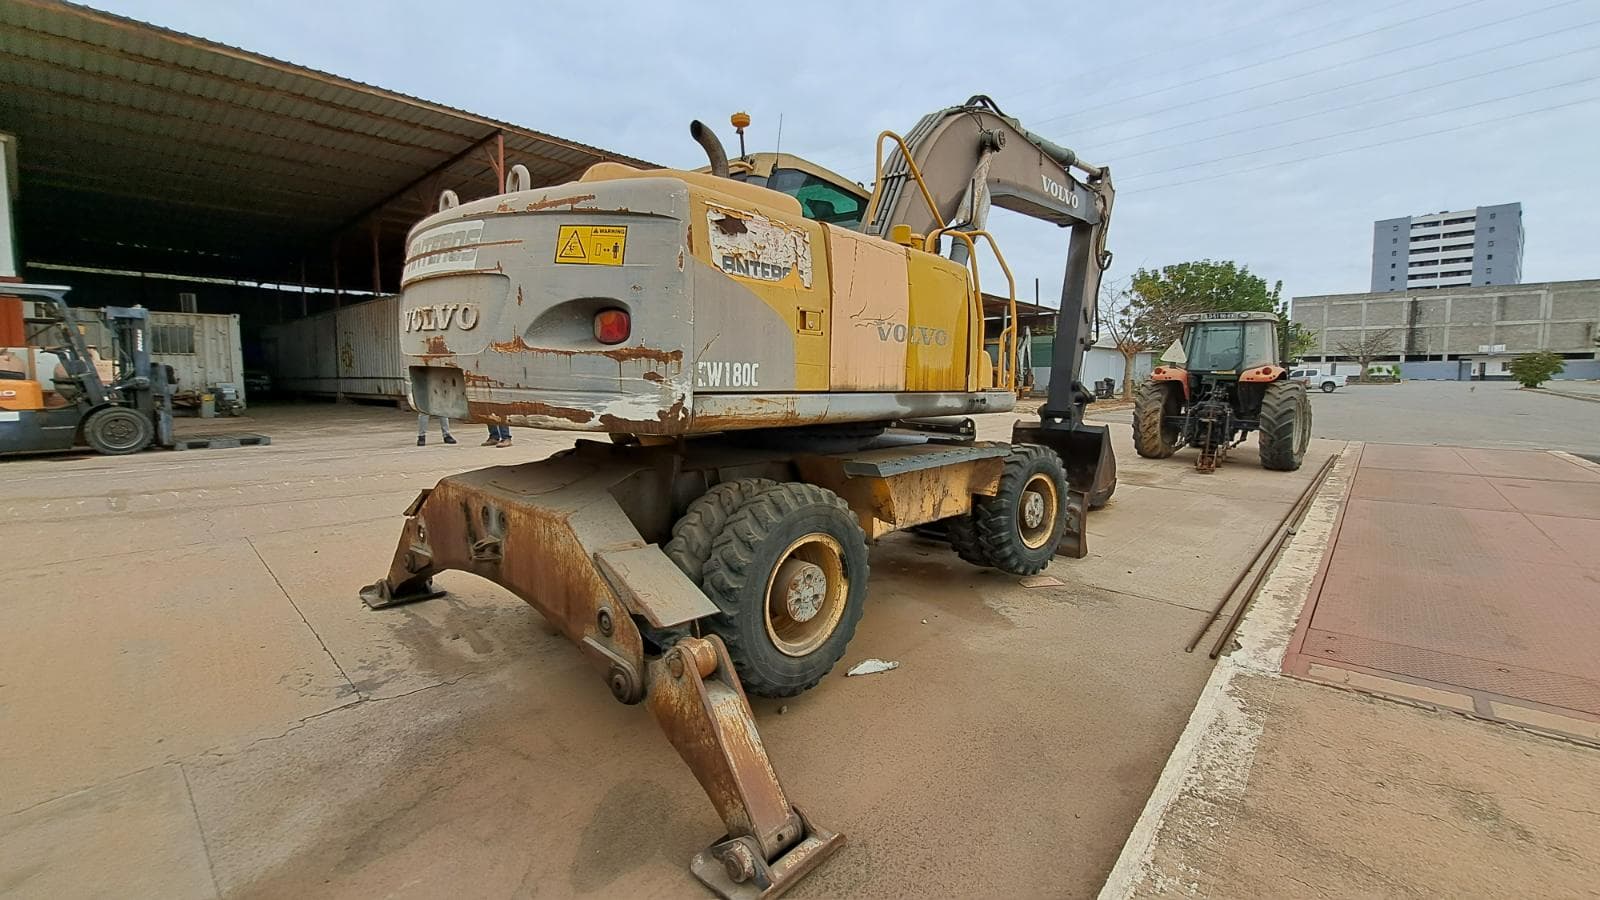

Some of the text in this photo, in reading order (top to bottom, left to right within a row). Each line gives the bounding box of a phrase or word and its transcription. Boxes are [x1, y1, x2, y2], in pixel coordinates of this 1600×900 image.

[1041, 174, 1079, 209] VOLVO
[722, 254, 805, 279] ANTER
[404, 302, 480, 333] VOLVO
[875, 321, 948, 346] VOLVO
[697, 361, 760, 387] EW180C
